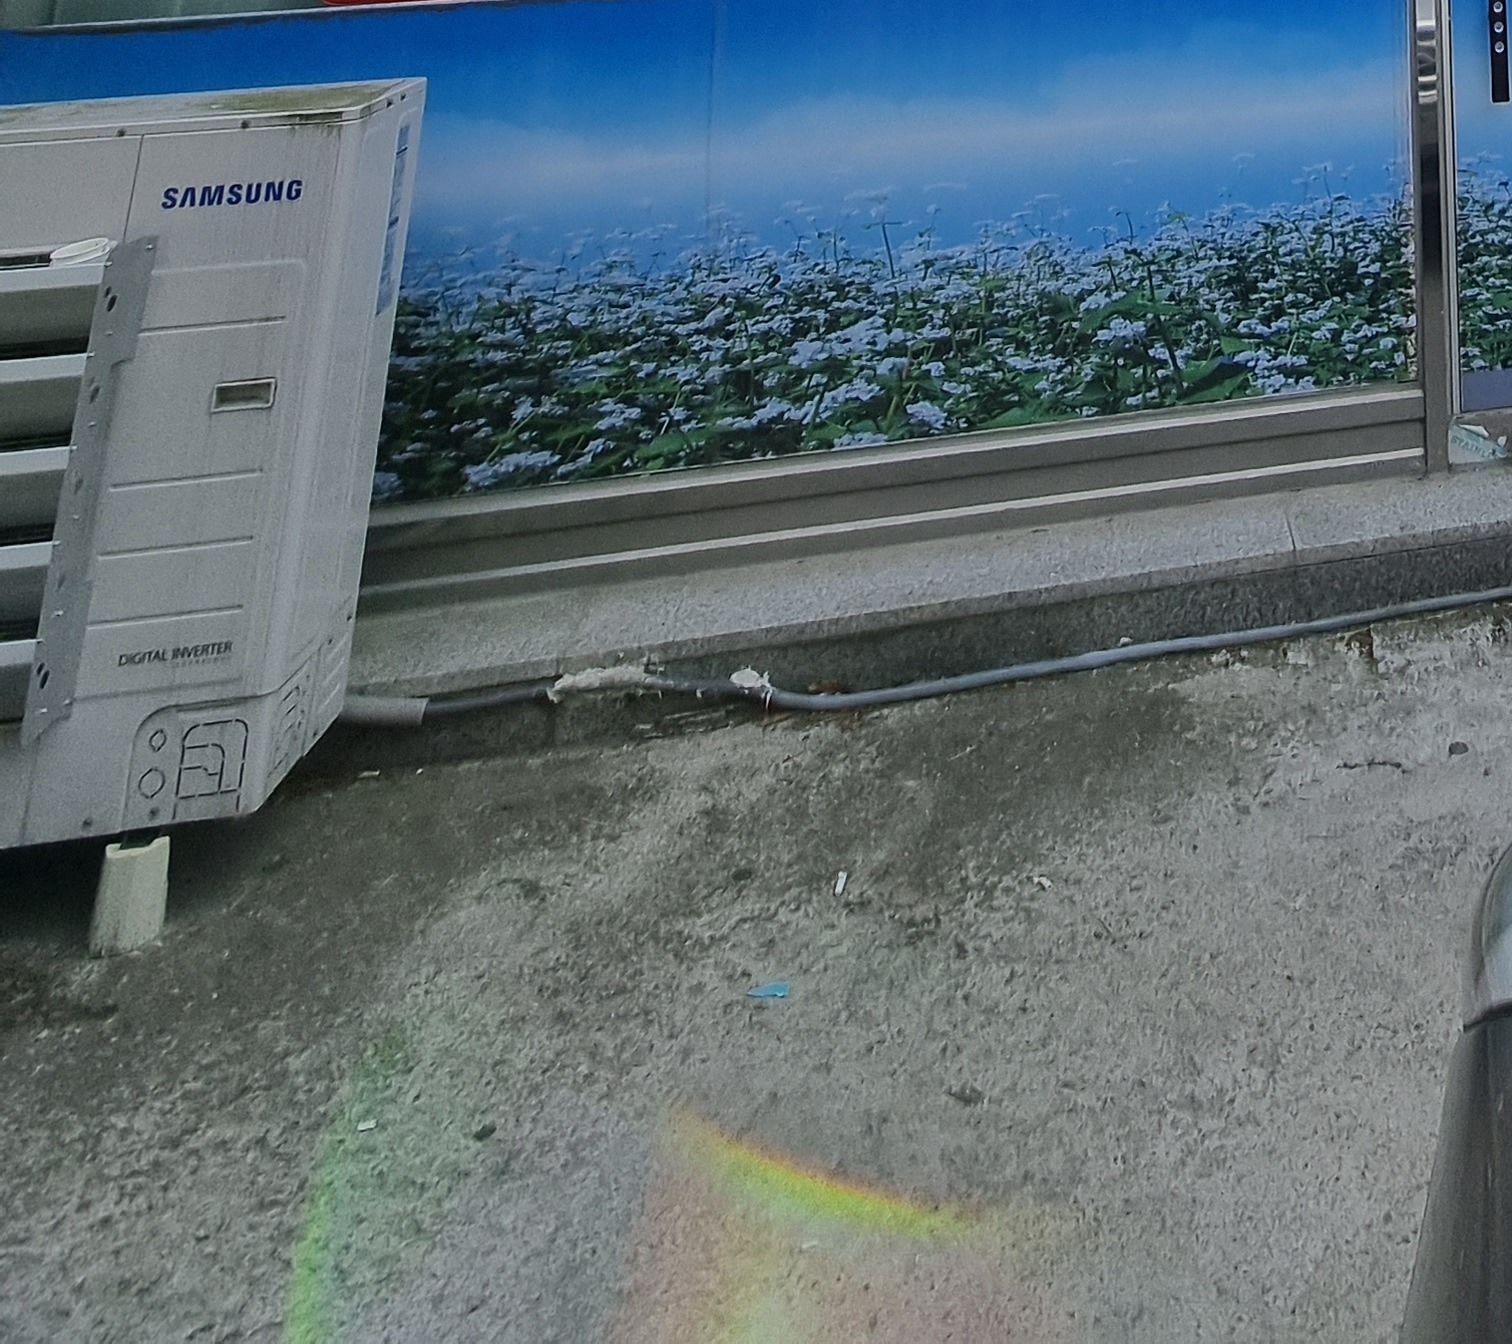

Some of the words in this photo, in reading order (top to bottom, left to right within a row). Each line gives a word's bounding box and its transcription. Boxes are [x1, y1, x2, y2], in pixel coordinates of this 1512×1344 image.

[161, 179, 303, 210] SAMSUNG
[118, 648, 168, 667] DIGITAL
[171, 640, 234, 661] INVERTER
